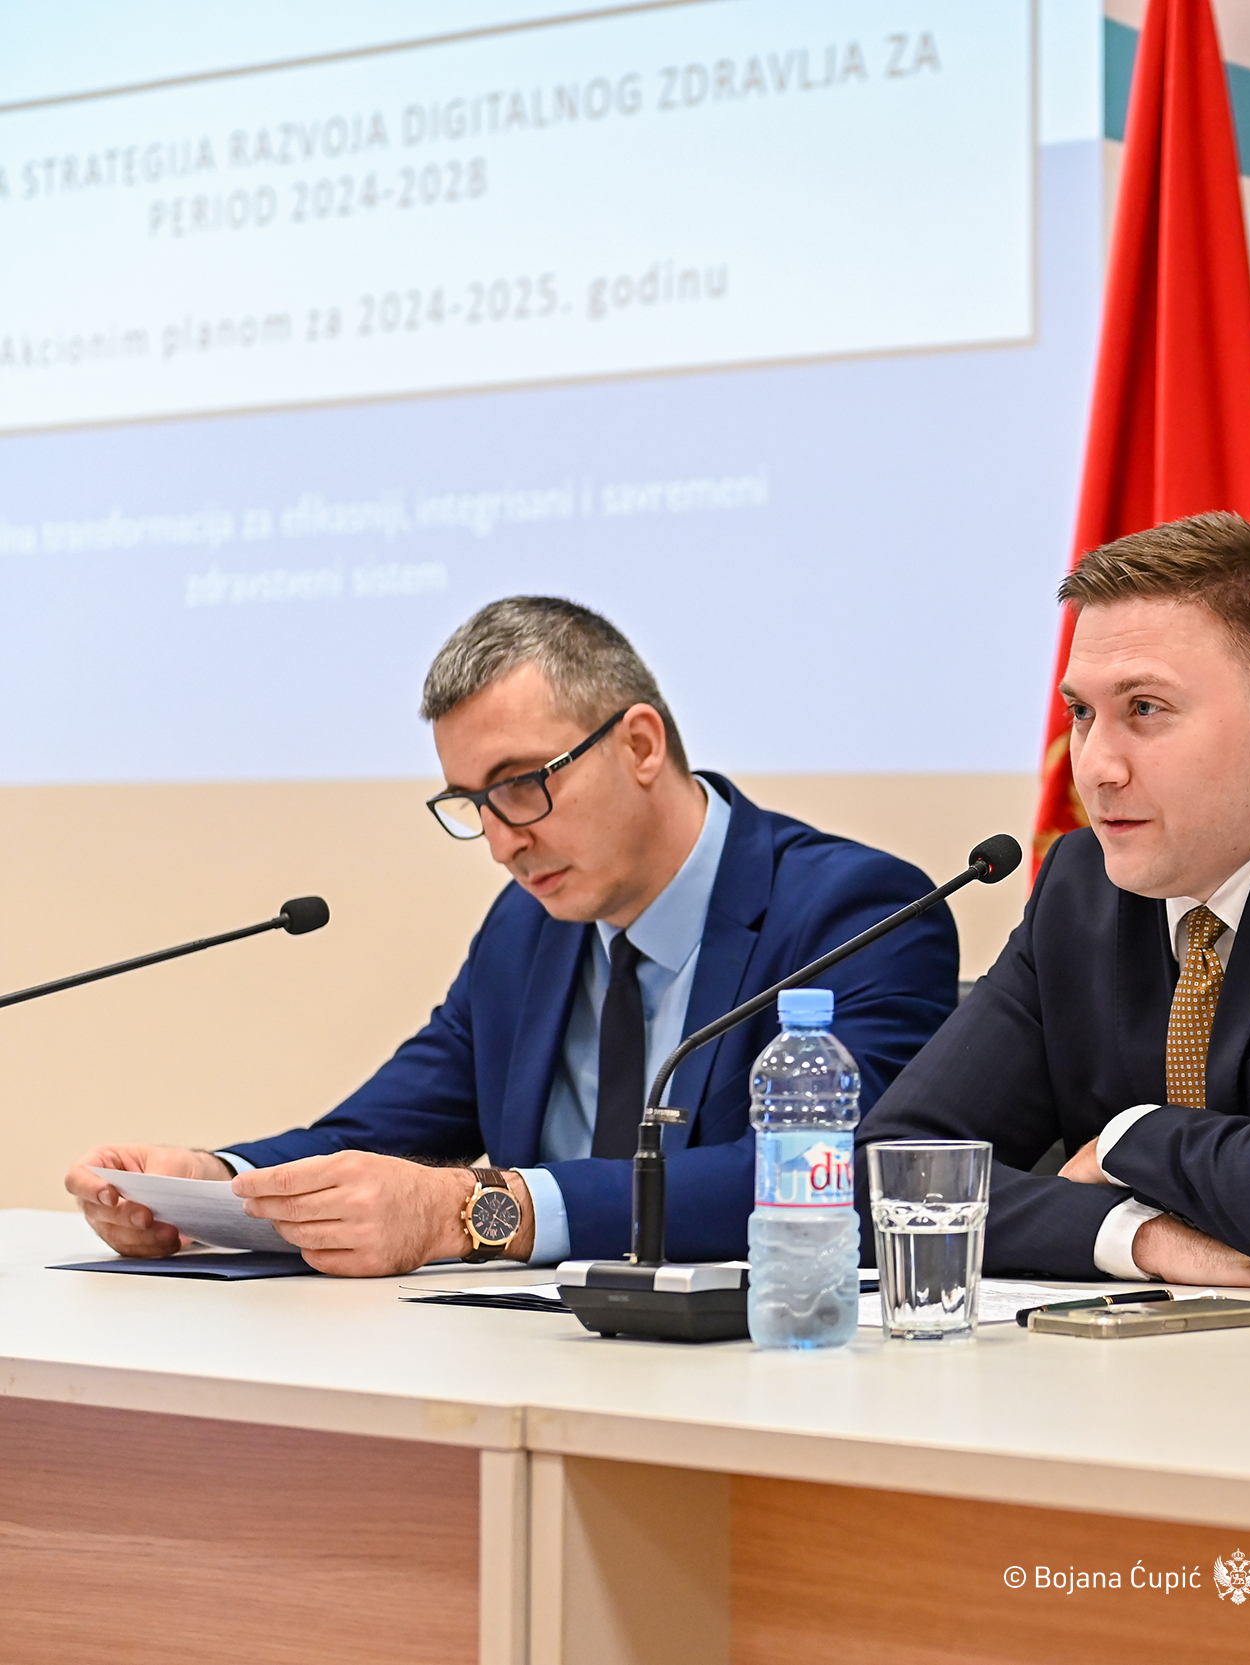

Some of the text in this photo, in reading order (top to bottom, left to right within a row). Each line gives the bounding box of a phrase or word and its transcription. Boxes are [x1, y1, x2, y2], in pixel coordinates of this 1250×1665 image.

[21, 136, 216, 201] STRATEGIJA
[228, 108, 390, 170] RAZVOJA
[402, 72, 643, 149] DIGITALNOG
[657, 40, 868, 112] ZDRAVLJA
[884, 29, 943, 80] ZA
[147, 156, 488, 240] PERIOD 2024-2028
[161, 310, 292, 366] planom
[304, 306, 342, 343] za
[357, 272, 573, 340] 2024-2025.
[586, 258, 730, 322] godinu
